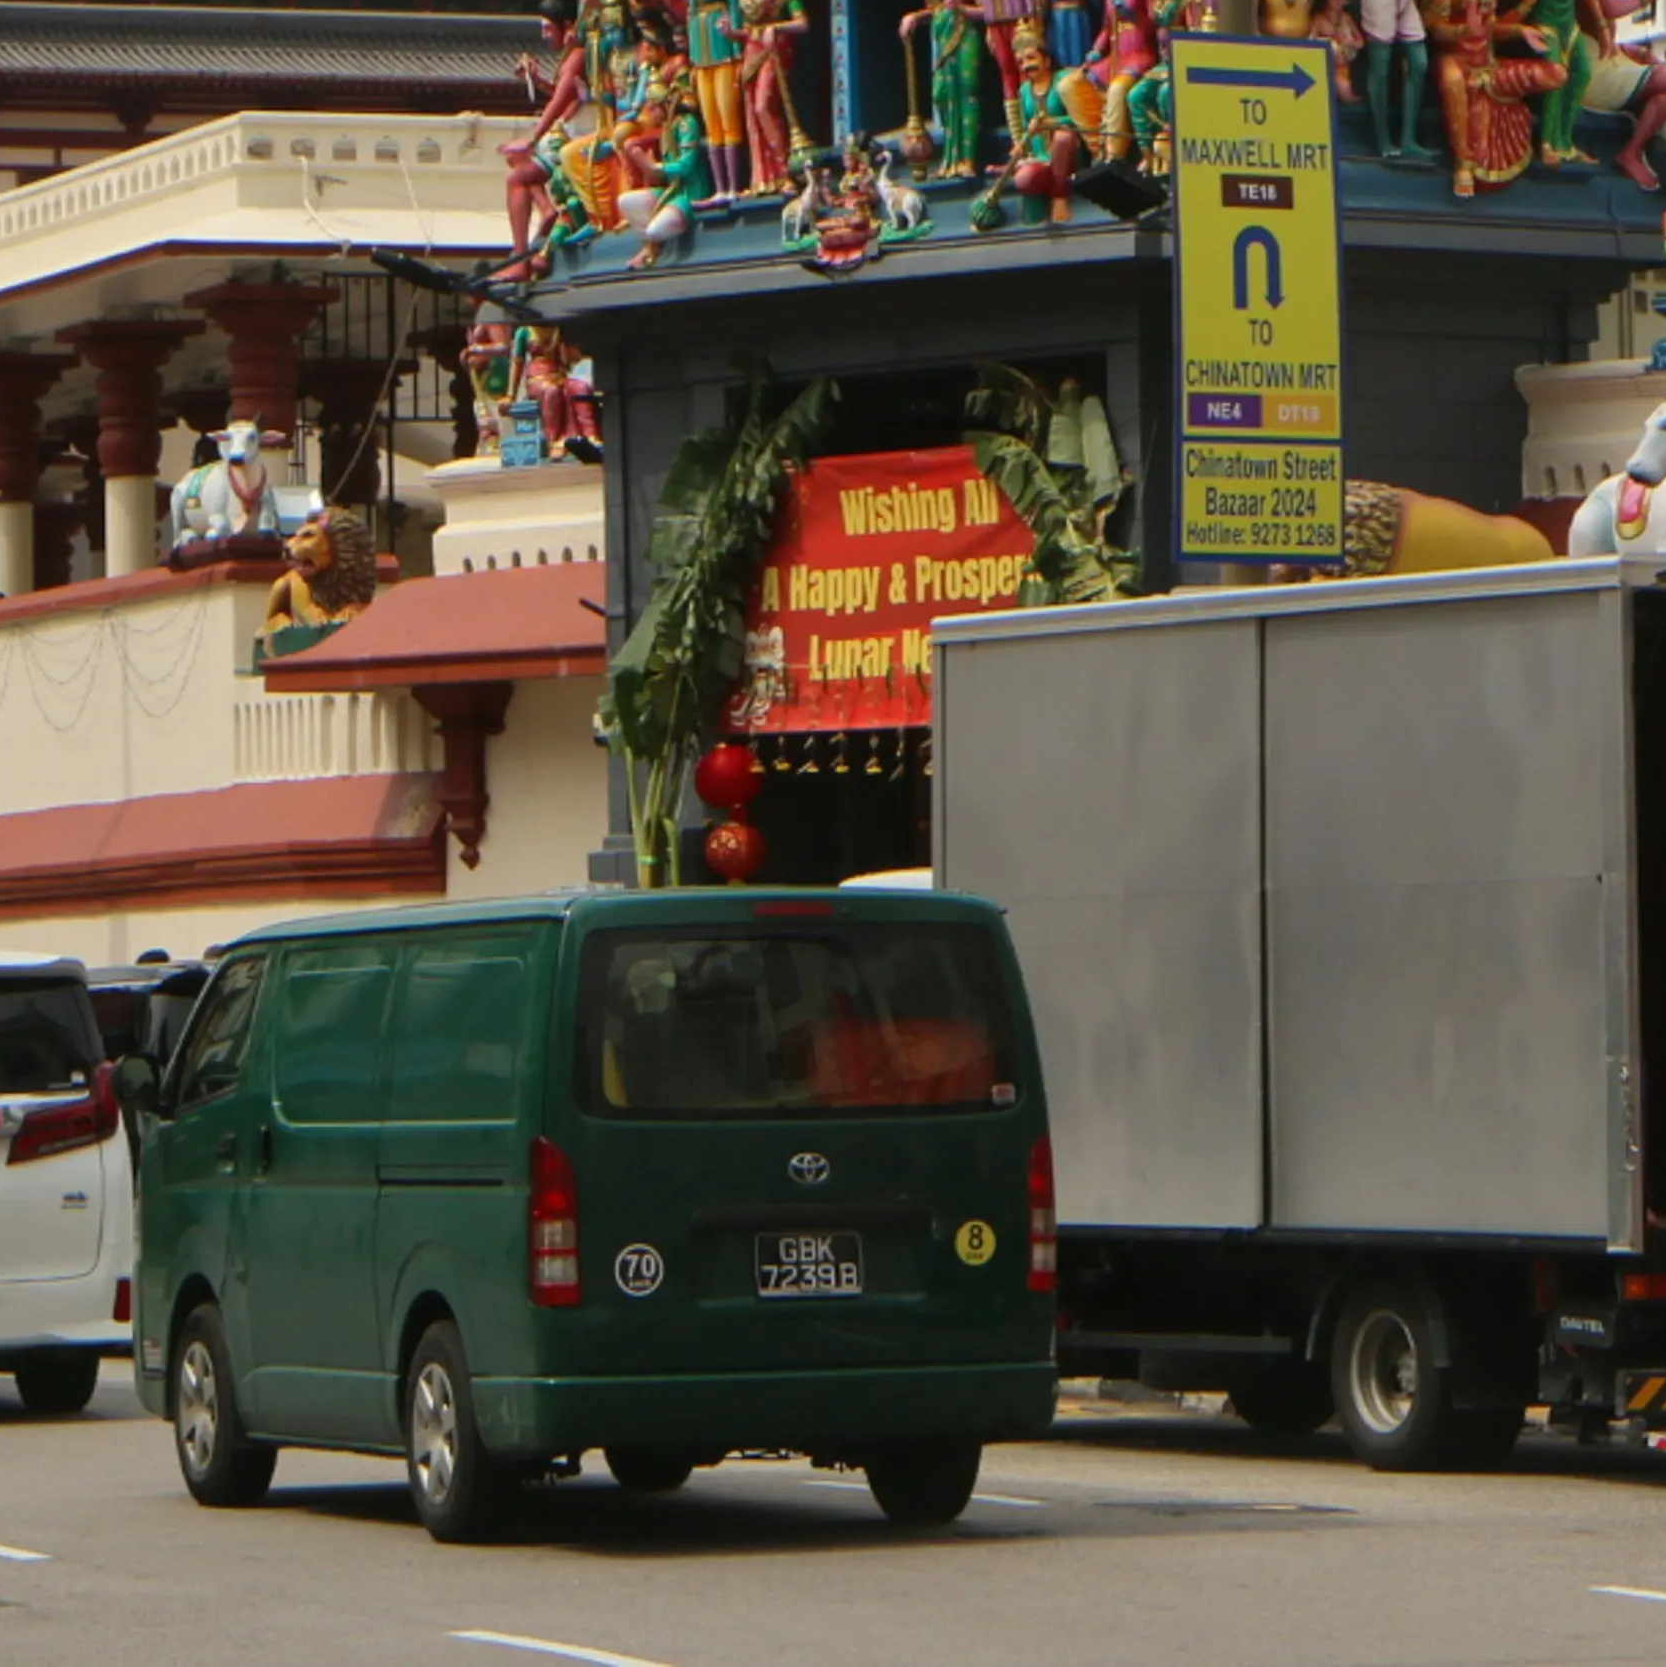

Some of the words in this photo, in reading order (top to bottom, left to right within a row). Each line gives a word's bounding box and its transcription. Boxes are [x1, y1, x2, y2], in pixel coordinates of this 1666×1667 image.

[1240, 99, 1267, 126] TO
[1181, 138, 1281, 169] MAXWELL
[1287, 144, 1328, 170] MRT
[1238, 182, 1278, 201] TE18
[1248, 319, 1273, 345] TO
[1186, 360, 1294, 389] CHINATOWN
[1299, 364, 1337, 390] MRT
[1207, 402, 1242, 420] NE4
[1186, 449, 1277, 482] Chinatown
[1283, 451, 1336, 482] Street
[840, 483, 955, 537] Wishing
[964, 478, 999, 525] All
[1205, 487, 1266, 517] Bazaar
[1271, 488, 1317, 517] 2024
[1186, 522, 1245, 545] Hotline:
[1251, 523, 1291, 546] 9273
[762, 566, 780, 611] A
[789, 562, 880, 616] Happy
[889, 563, 907, 604] &
[916, 553, 1032, 605] Prosper
[809, 633, 894, 681] Lunar
[902, 629, 932, 674] Ne
[778, 1237, 836, 1262] GBK
[967, 1223, 984, 1251] 8
[625, 1253, 656, 1278] 70
[760, 1263, 859, 1292] 7239B
[1560, 1316, 1605, 1334] DAUTEL
